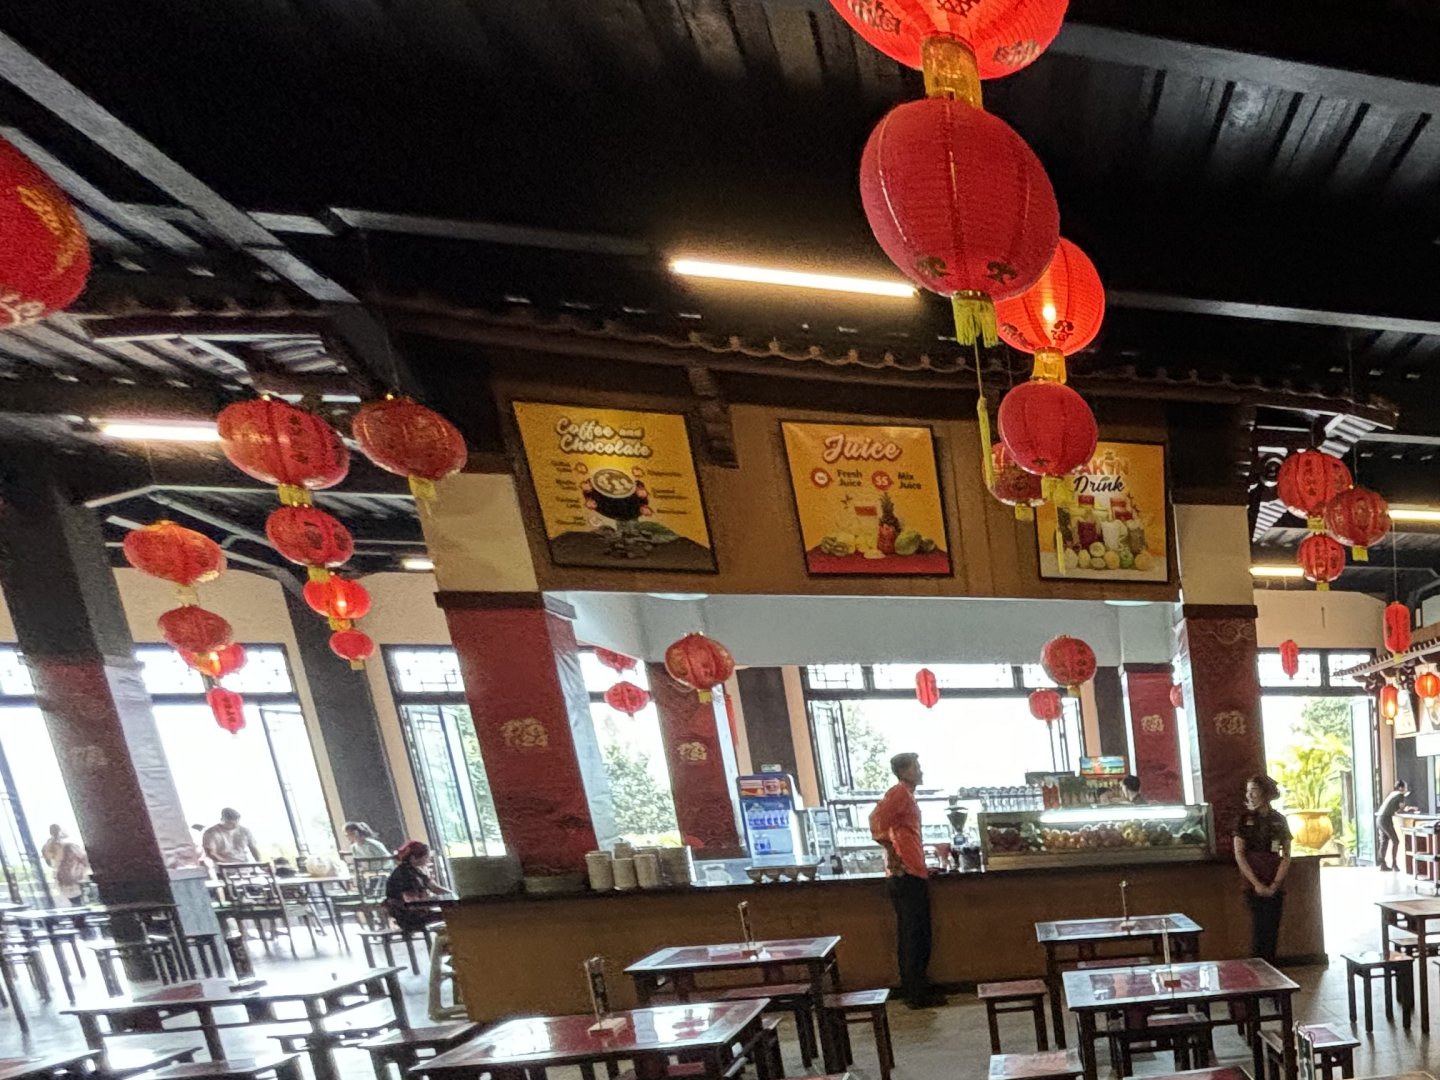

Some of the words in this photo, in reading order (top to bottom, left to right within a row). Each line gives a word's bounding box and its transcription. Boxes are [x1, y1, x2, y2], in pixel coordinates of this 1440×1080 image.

[556, 417, 616, 441] Coffee
[618, 426, 644, 439] and
[560, 434, 653, 458] Chocolate
[823, 433, 902, 463] Juice
[836, 469, 863, 479] Fresh
[897, 471, 914, 481] Mix
[838, 478, 862, 488] Juice
[898, 481, 921, 490] Juice
[1073, 475, 1125, 494] Drink
